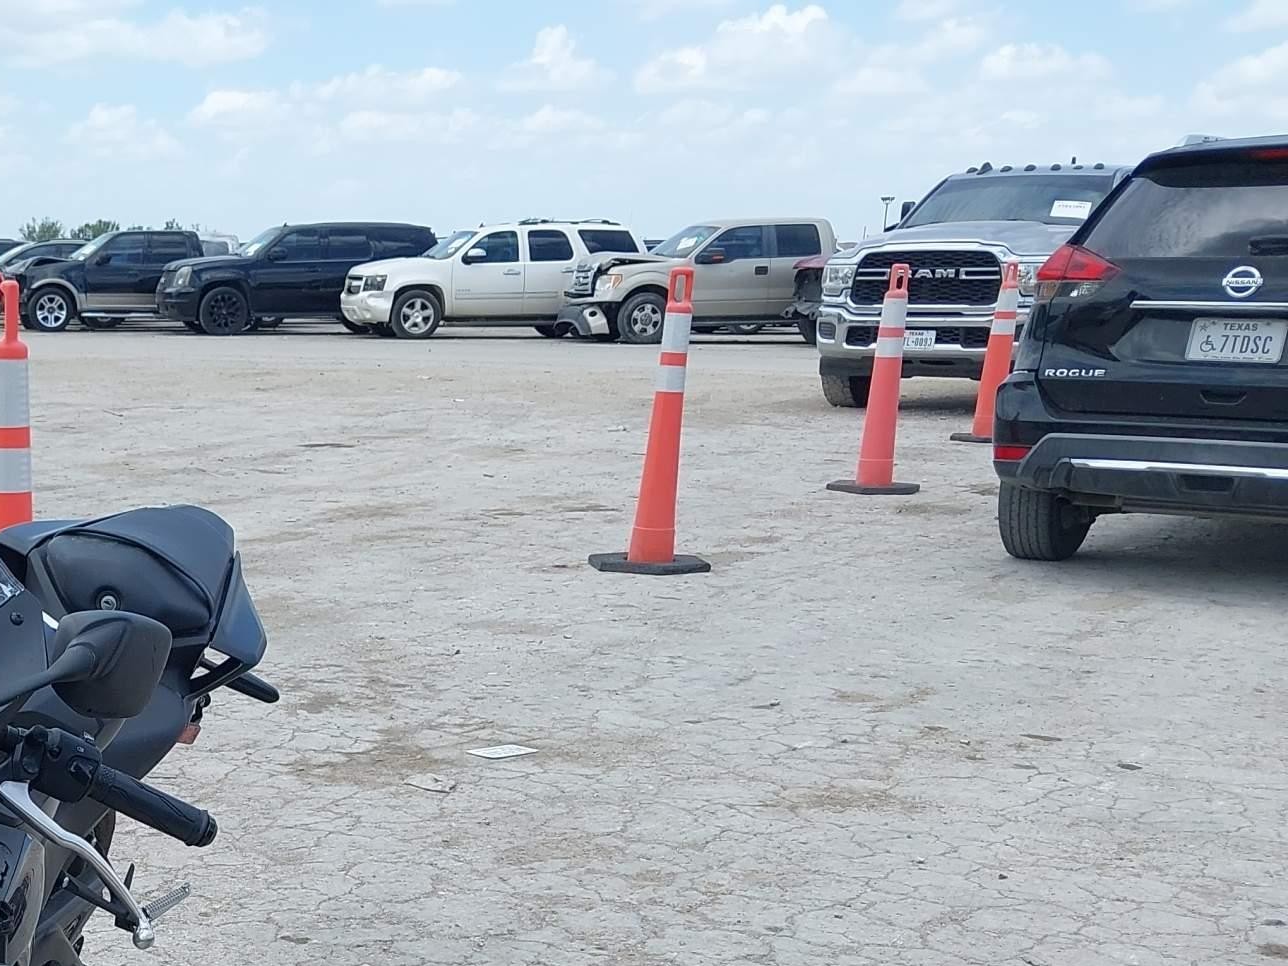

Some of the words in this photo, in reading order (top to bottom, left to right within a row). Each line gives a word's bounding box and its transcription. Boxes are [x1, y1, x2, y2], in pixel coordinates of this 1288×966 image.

[1223, 322, 1259, 332] TEXAS
[1220, 334, 1273, 355] 7TDSC
[1044, 368, 1106, 377] ROGUE
